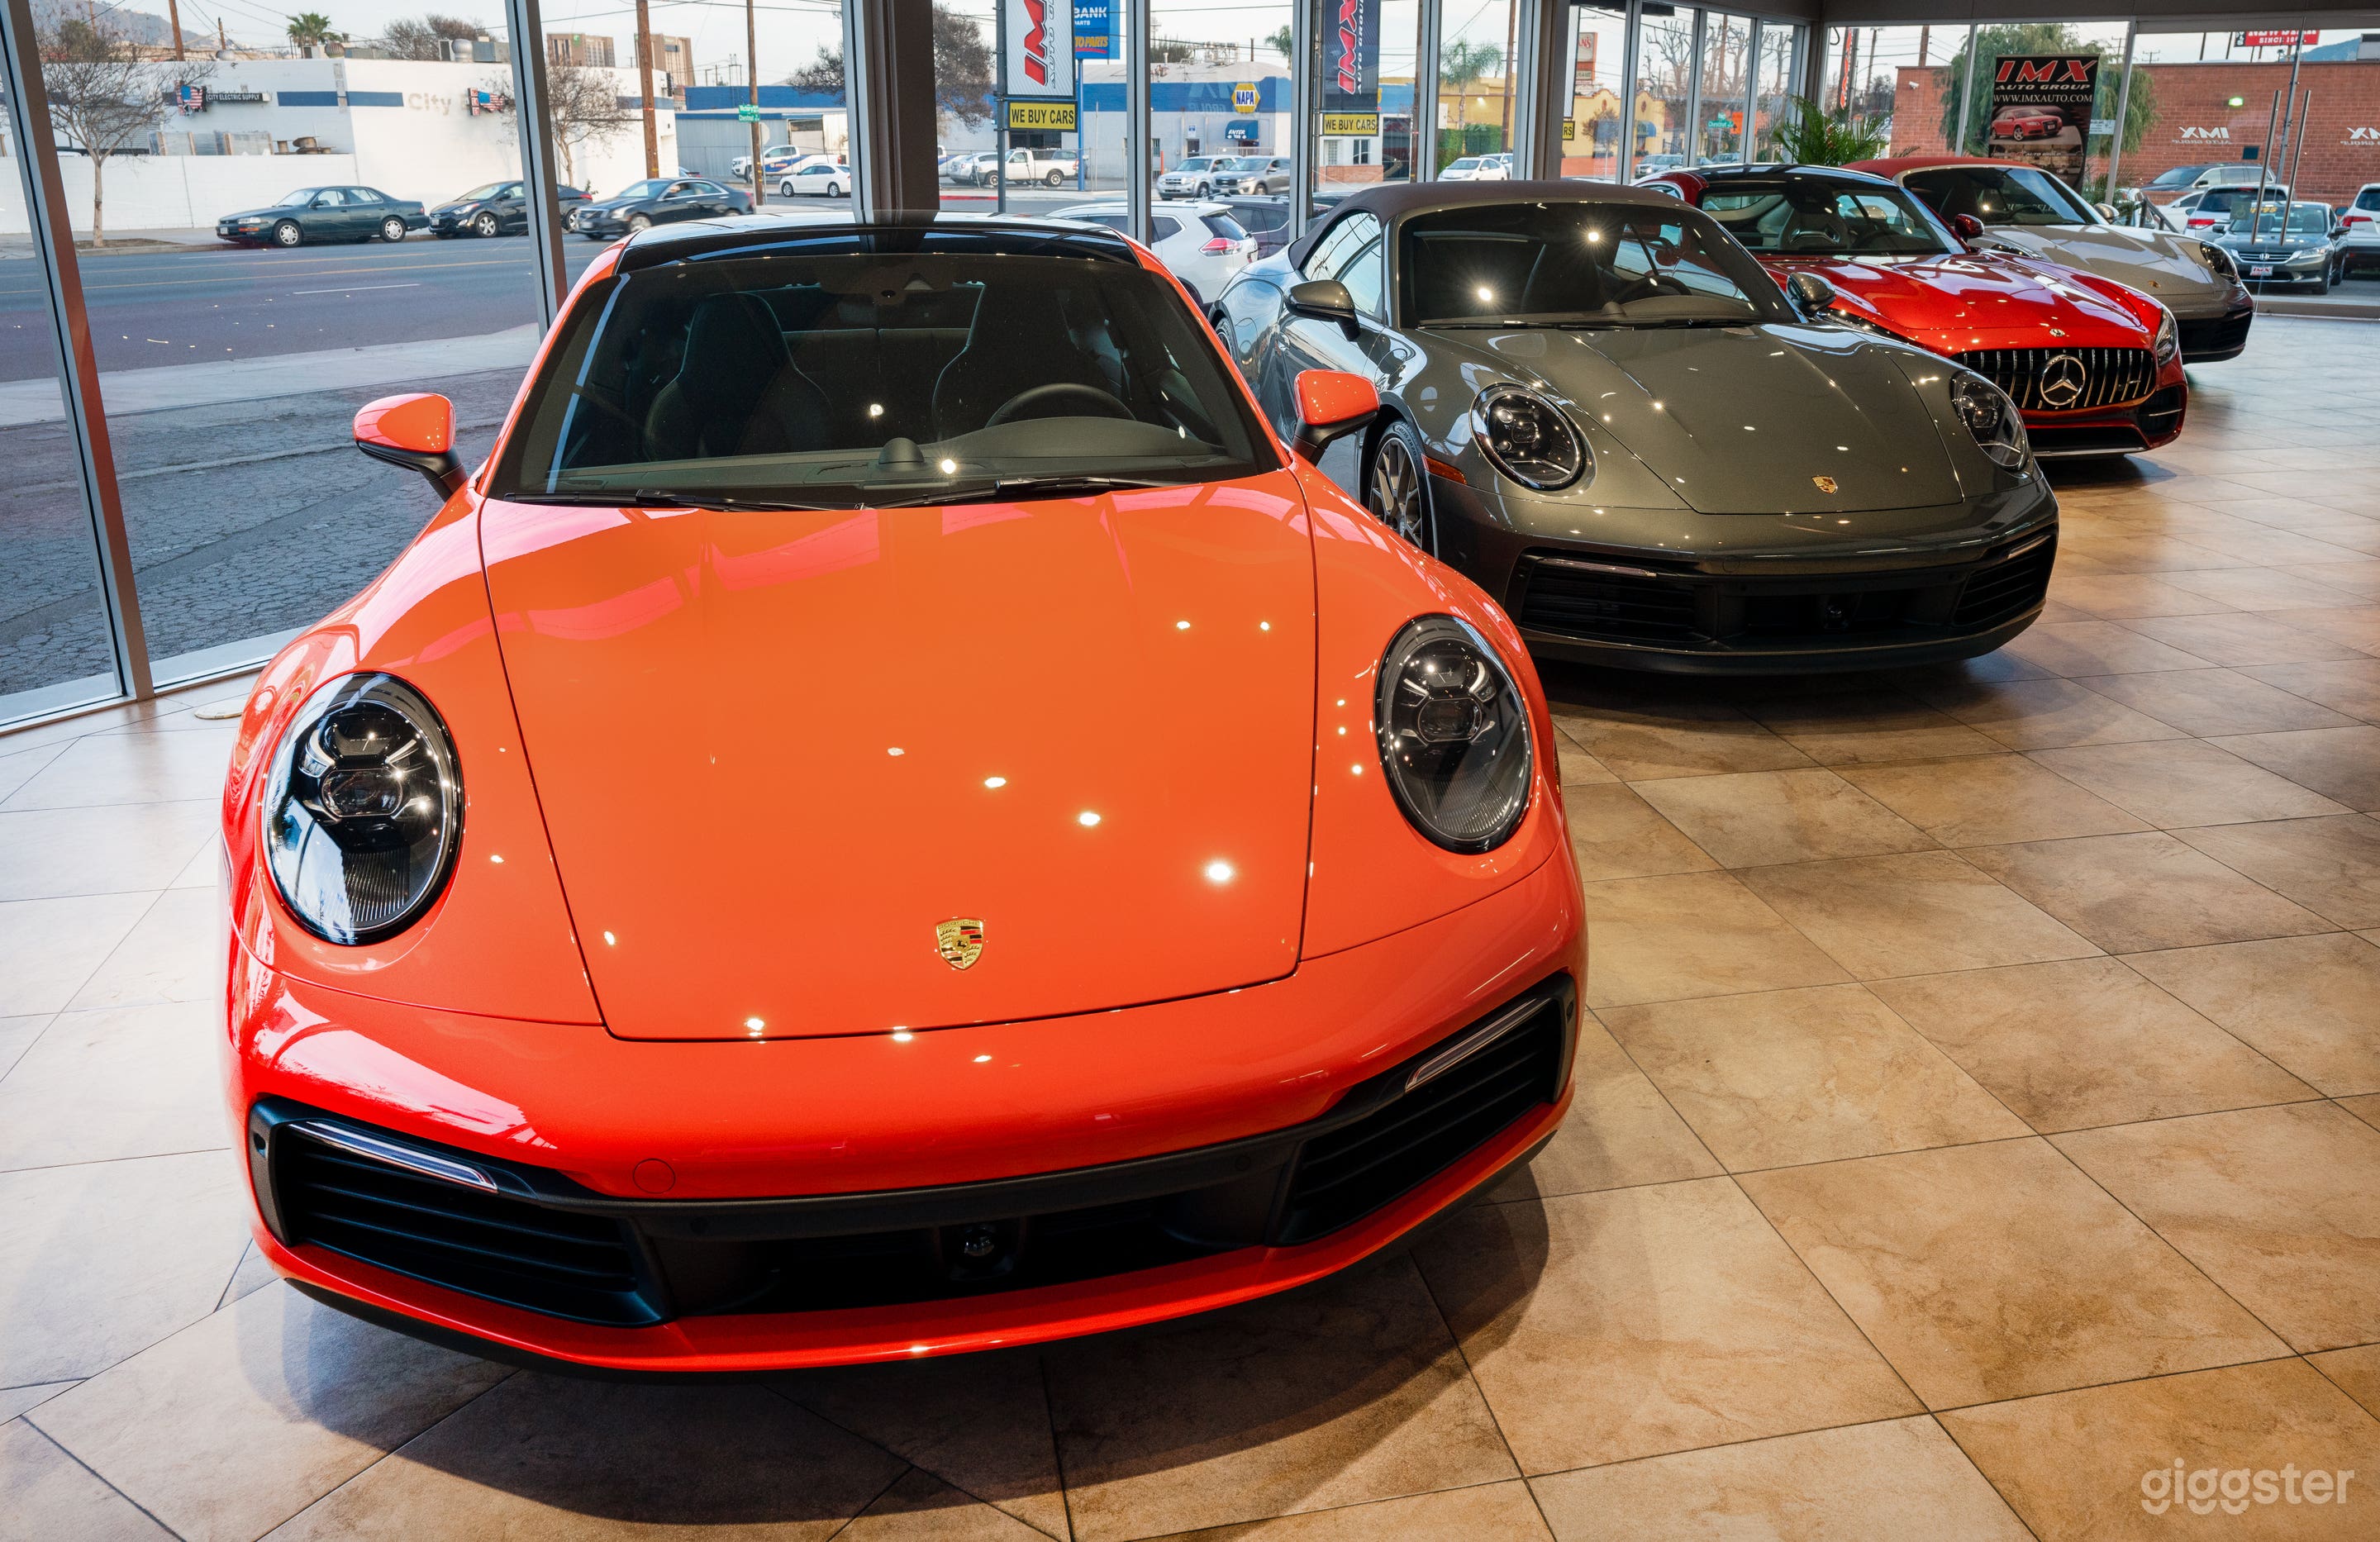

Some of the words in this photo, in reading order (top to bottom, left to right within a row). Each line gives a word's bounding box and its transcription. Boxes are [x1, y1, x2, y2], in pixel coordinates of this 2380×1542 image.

[1085, 36, 1108, 47] PARTS
[1048, 26, 1056, 89] AUTO
[1996, 60, 2097, 82] IMX
[219, 93, 242, 101] ELECTRIC
[242, 93, 260, 101] SUPPLY
[1235, 91, 1254, 105] NAPA
[1993, 94, 2092, 102] WWW.IMXAUTO.COM
[408, 93, 451, 116] City
[1011, 108, 1026, 123] WE
[1028, 108, 1046, 123] BUY
[1050, 109, 1074, 124] CARS
[1325, 119, 1336, 131] WE
[1339, 119, 1354, 131] BUY
[1356, 119, 1376, 131] CARS
